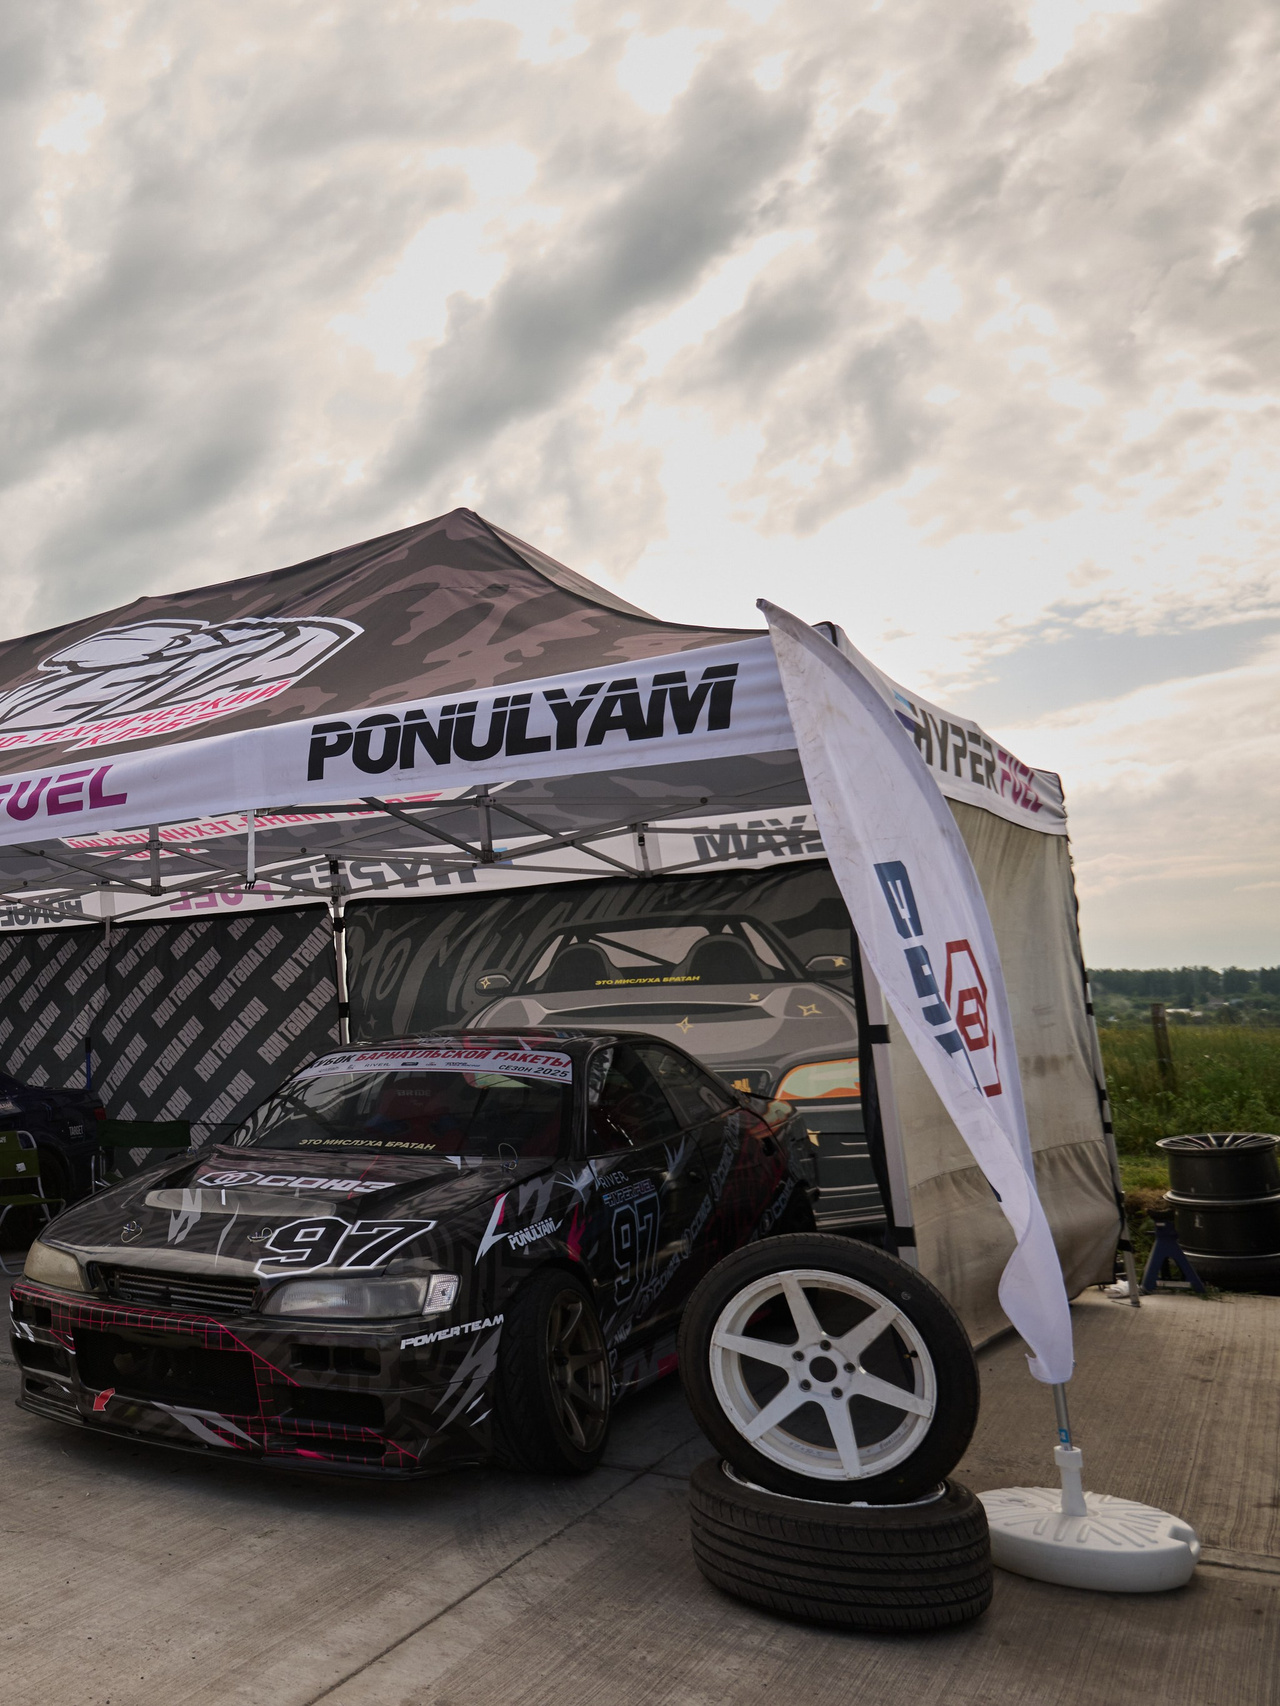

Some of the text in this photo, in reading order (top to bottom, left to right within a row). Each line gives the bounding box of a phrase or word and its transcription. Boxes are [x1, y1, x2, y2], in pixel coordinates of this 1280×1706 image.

[307, 663, 739, 781] PONULYAM
[911, 702, 1043, 813] HYPER FUEL
[614, 977, 661, 985] МИСЛУХА
[662, 975, 701, 983] БРАТАН
[307, 1054, 356, 1070] КУБОК
[357, 1049, 490, 1062] БАРНАУЛЬСКОЙ
[492, 1051, 572, 1067] РАКЕТЫ
[499, 1064, 570, 1077] СЕЗОН 2025
[299, 1138, 437, 1150] ЭТО МИСЛУХА БРАТАН
[257, 1175, 396, 1194] СОЮЗ
[599, 1170, 630, 1189] RIVER
[507, 1216, 557, 1250] PONULYAM
[253, 1215, 438, 1279] 97
[611, 1192, 660, 1306] 97
